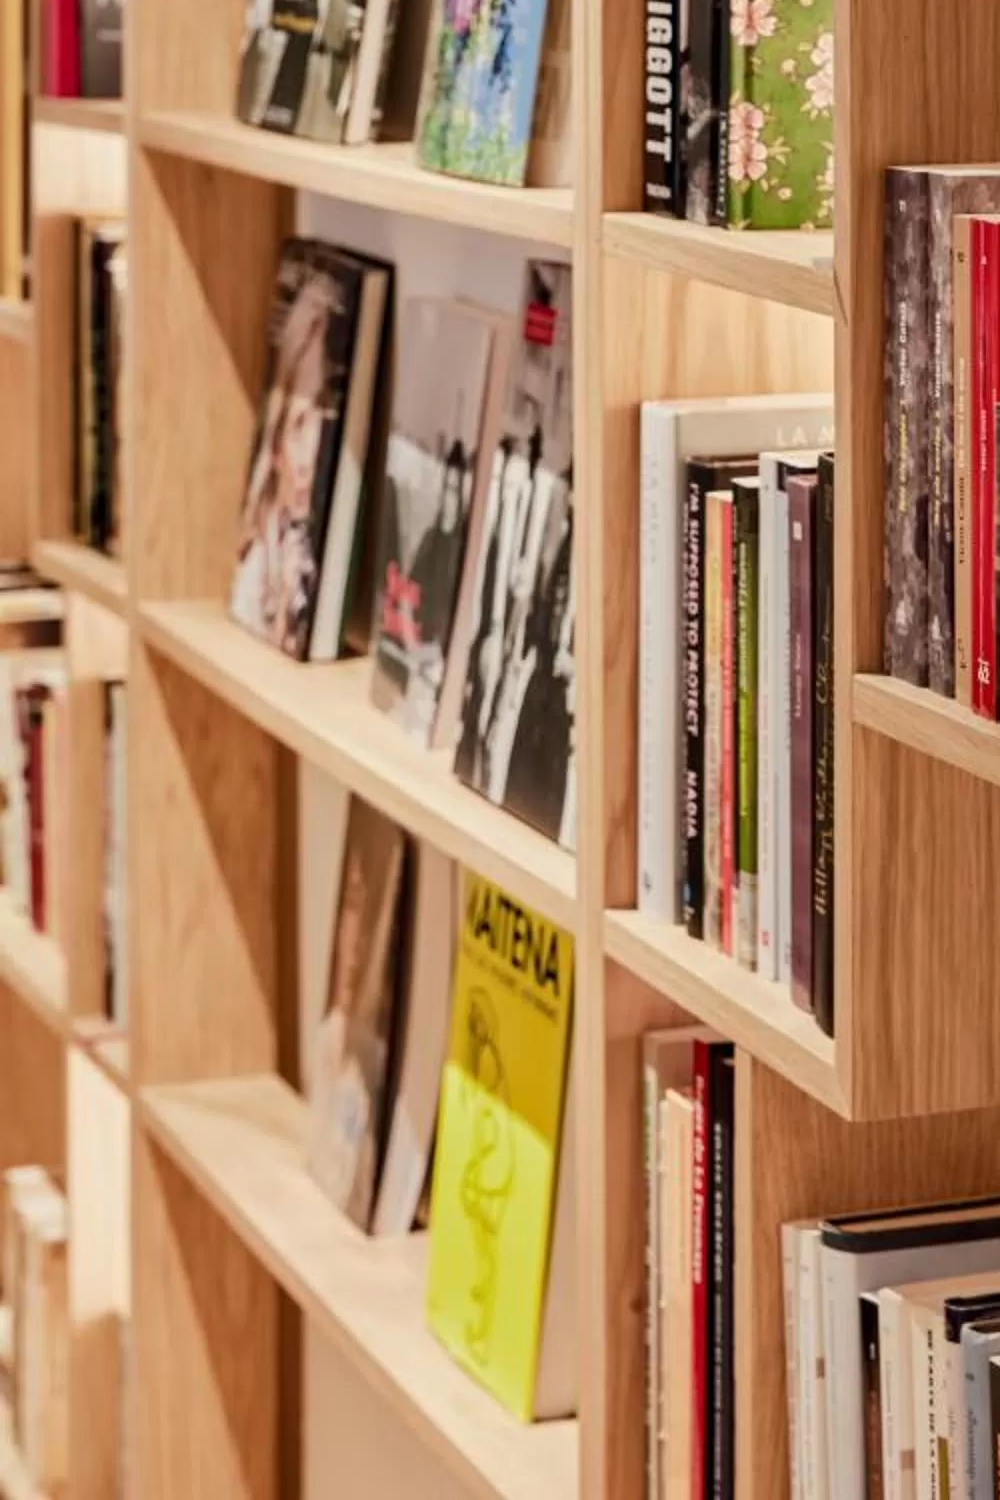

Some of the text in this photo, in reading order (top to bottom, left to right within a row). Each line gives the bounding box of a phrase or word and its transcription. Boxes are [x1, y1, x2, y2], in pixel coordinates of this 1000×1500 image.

[688, 519, 699, 616] SUPPOSED
[688, 620, 699, 645] TO
[687, 650, 699, 738] PROTECT
